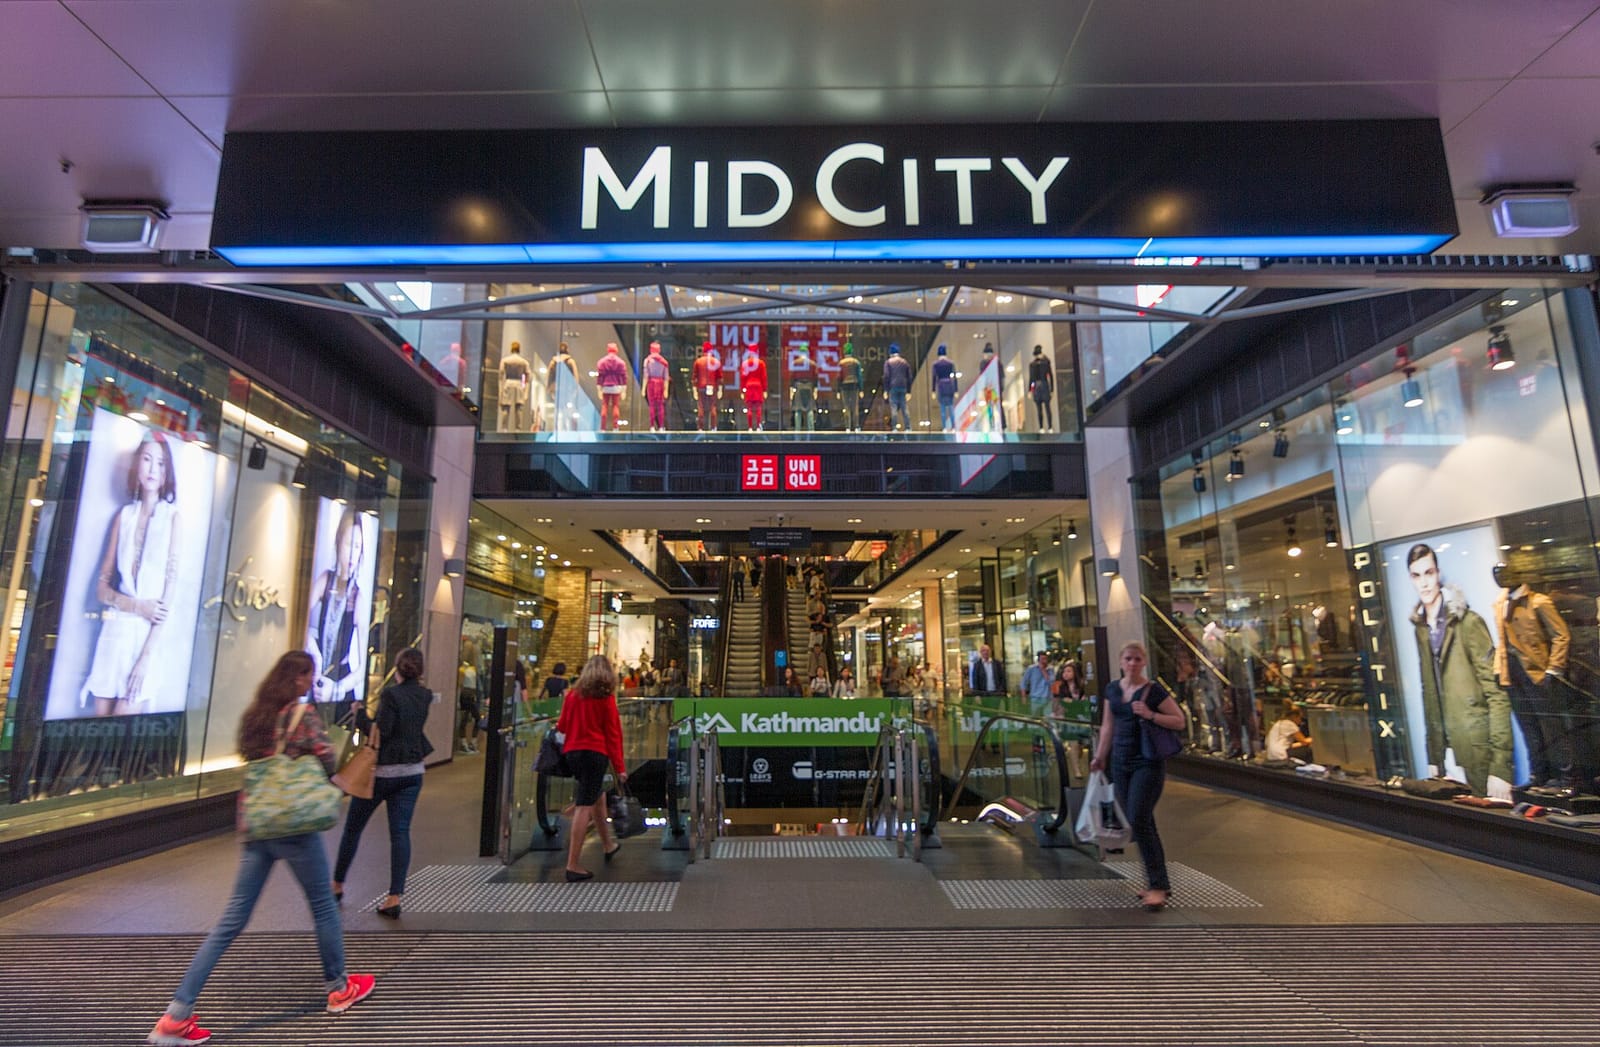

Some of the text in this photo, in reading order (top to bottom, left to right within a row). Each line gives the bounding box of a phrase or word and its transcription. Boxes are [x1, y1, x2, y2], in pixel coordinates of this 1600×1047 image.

[788, 459, 815, 472] UNI
[788, 473, 817, 488] QLO
[1353, 552, 1397, 738] POLITIX
[741, 711, 880, 733] Kathmandu
